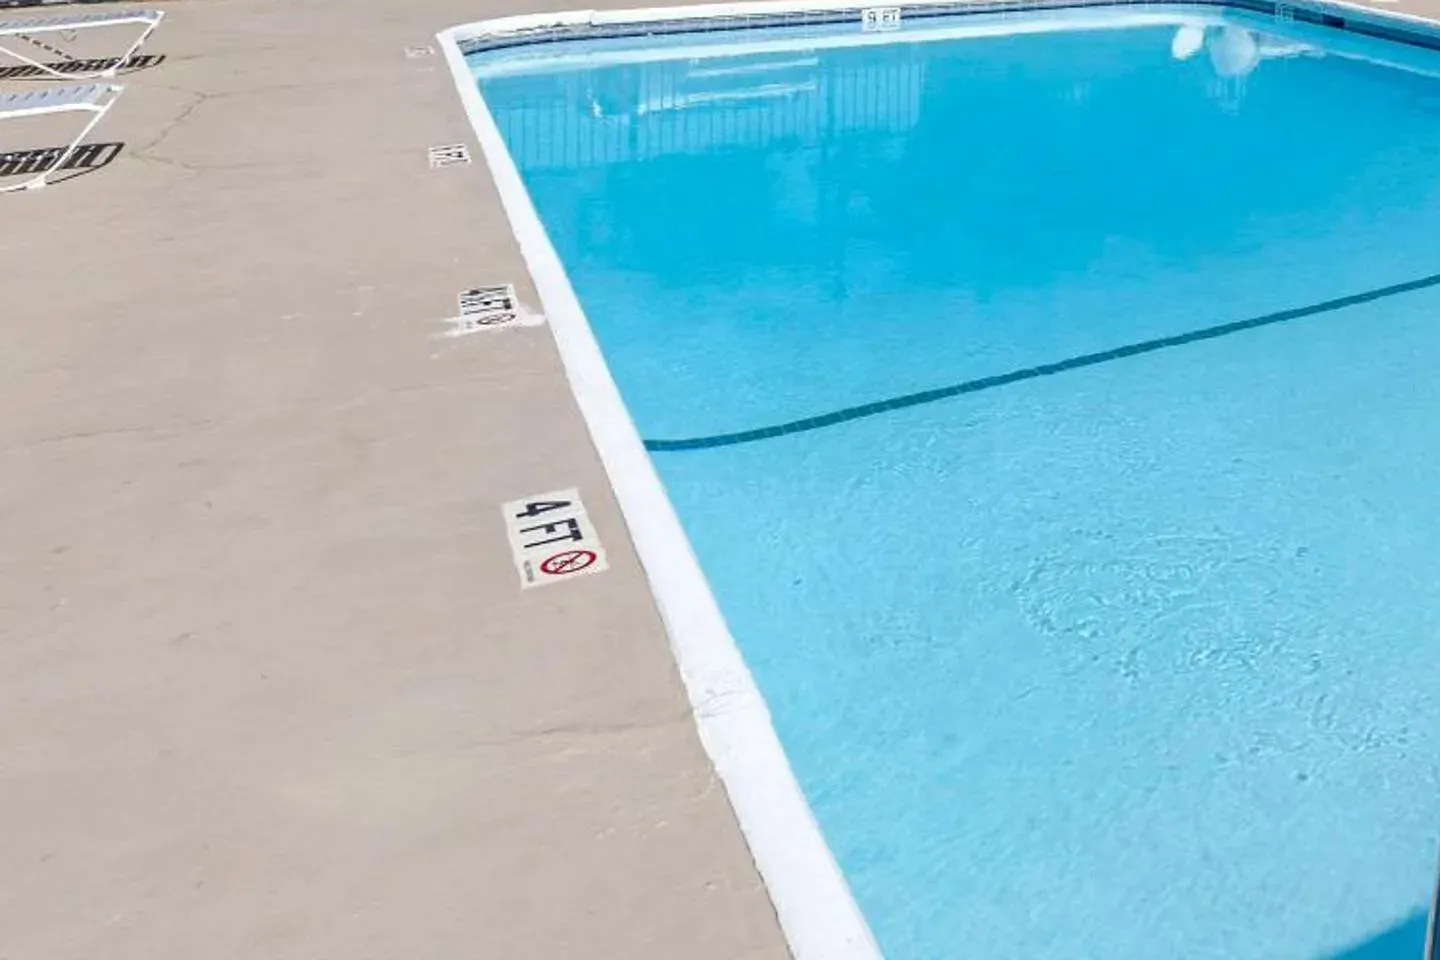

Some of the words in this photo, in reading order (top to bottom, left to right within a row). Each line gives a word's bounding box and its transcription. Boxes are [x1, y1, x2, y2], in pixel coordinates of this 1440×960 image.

[883, 9, 898, 21] FT
[516, 501, 571, 518] 4
[520, 518, 583, 548] FT
